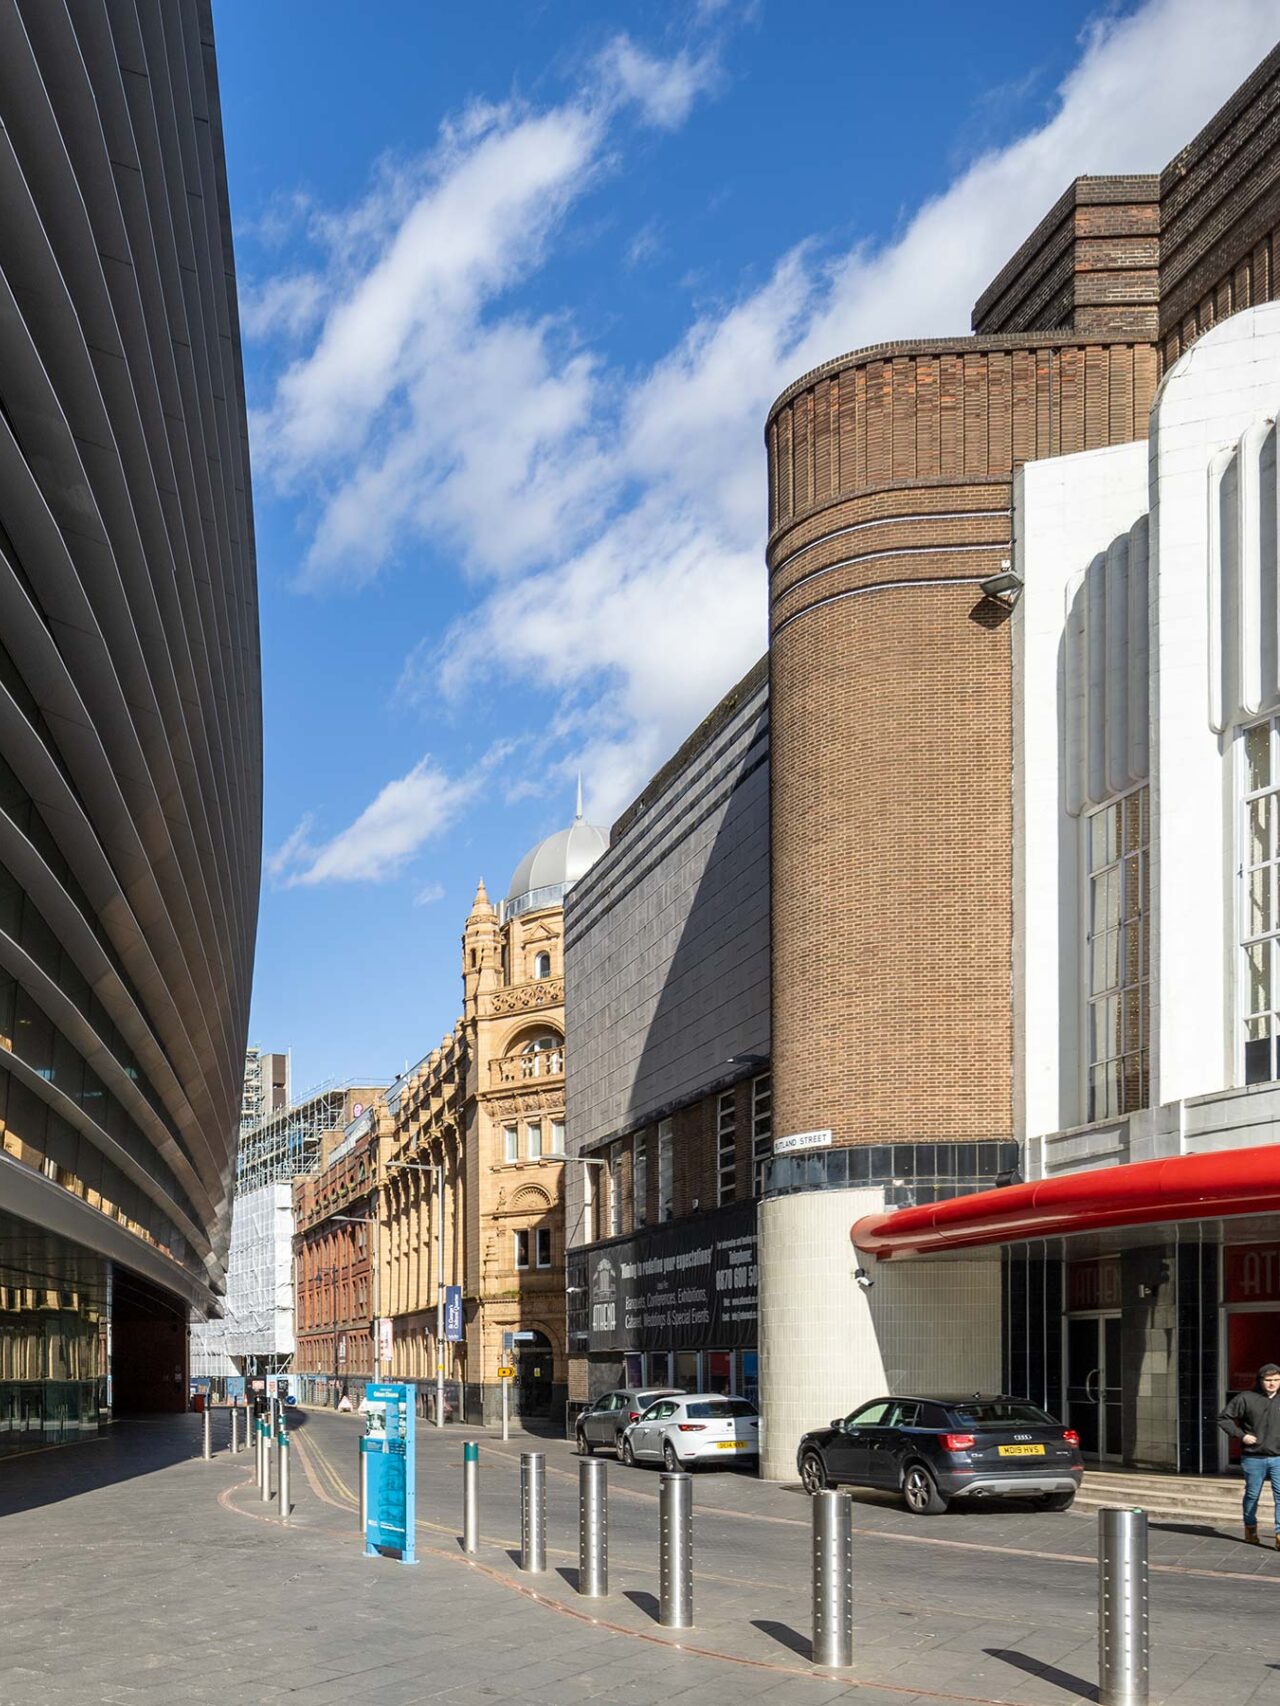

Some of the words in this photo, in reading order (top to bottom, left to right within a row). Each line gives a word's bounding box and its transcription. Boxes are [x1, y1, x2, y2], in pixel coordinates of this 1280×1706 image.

[800, 1134, 827, 1145] STREET
[663, 1256, 676, 1274] your
[592, 1302, 617, 1331] ATHENA
[643, 1311, 666, 1329] Weddings
[671, 1309, 691, 1327] Special
[691, 1307, 710, 1323] Events
